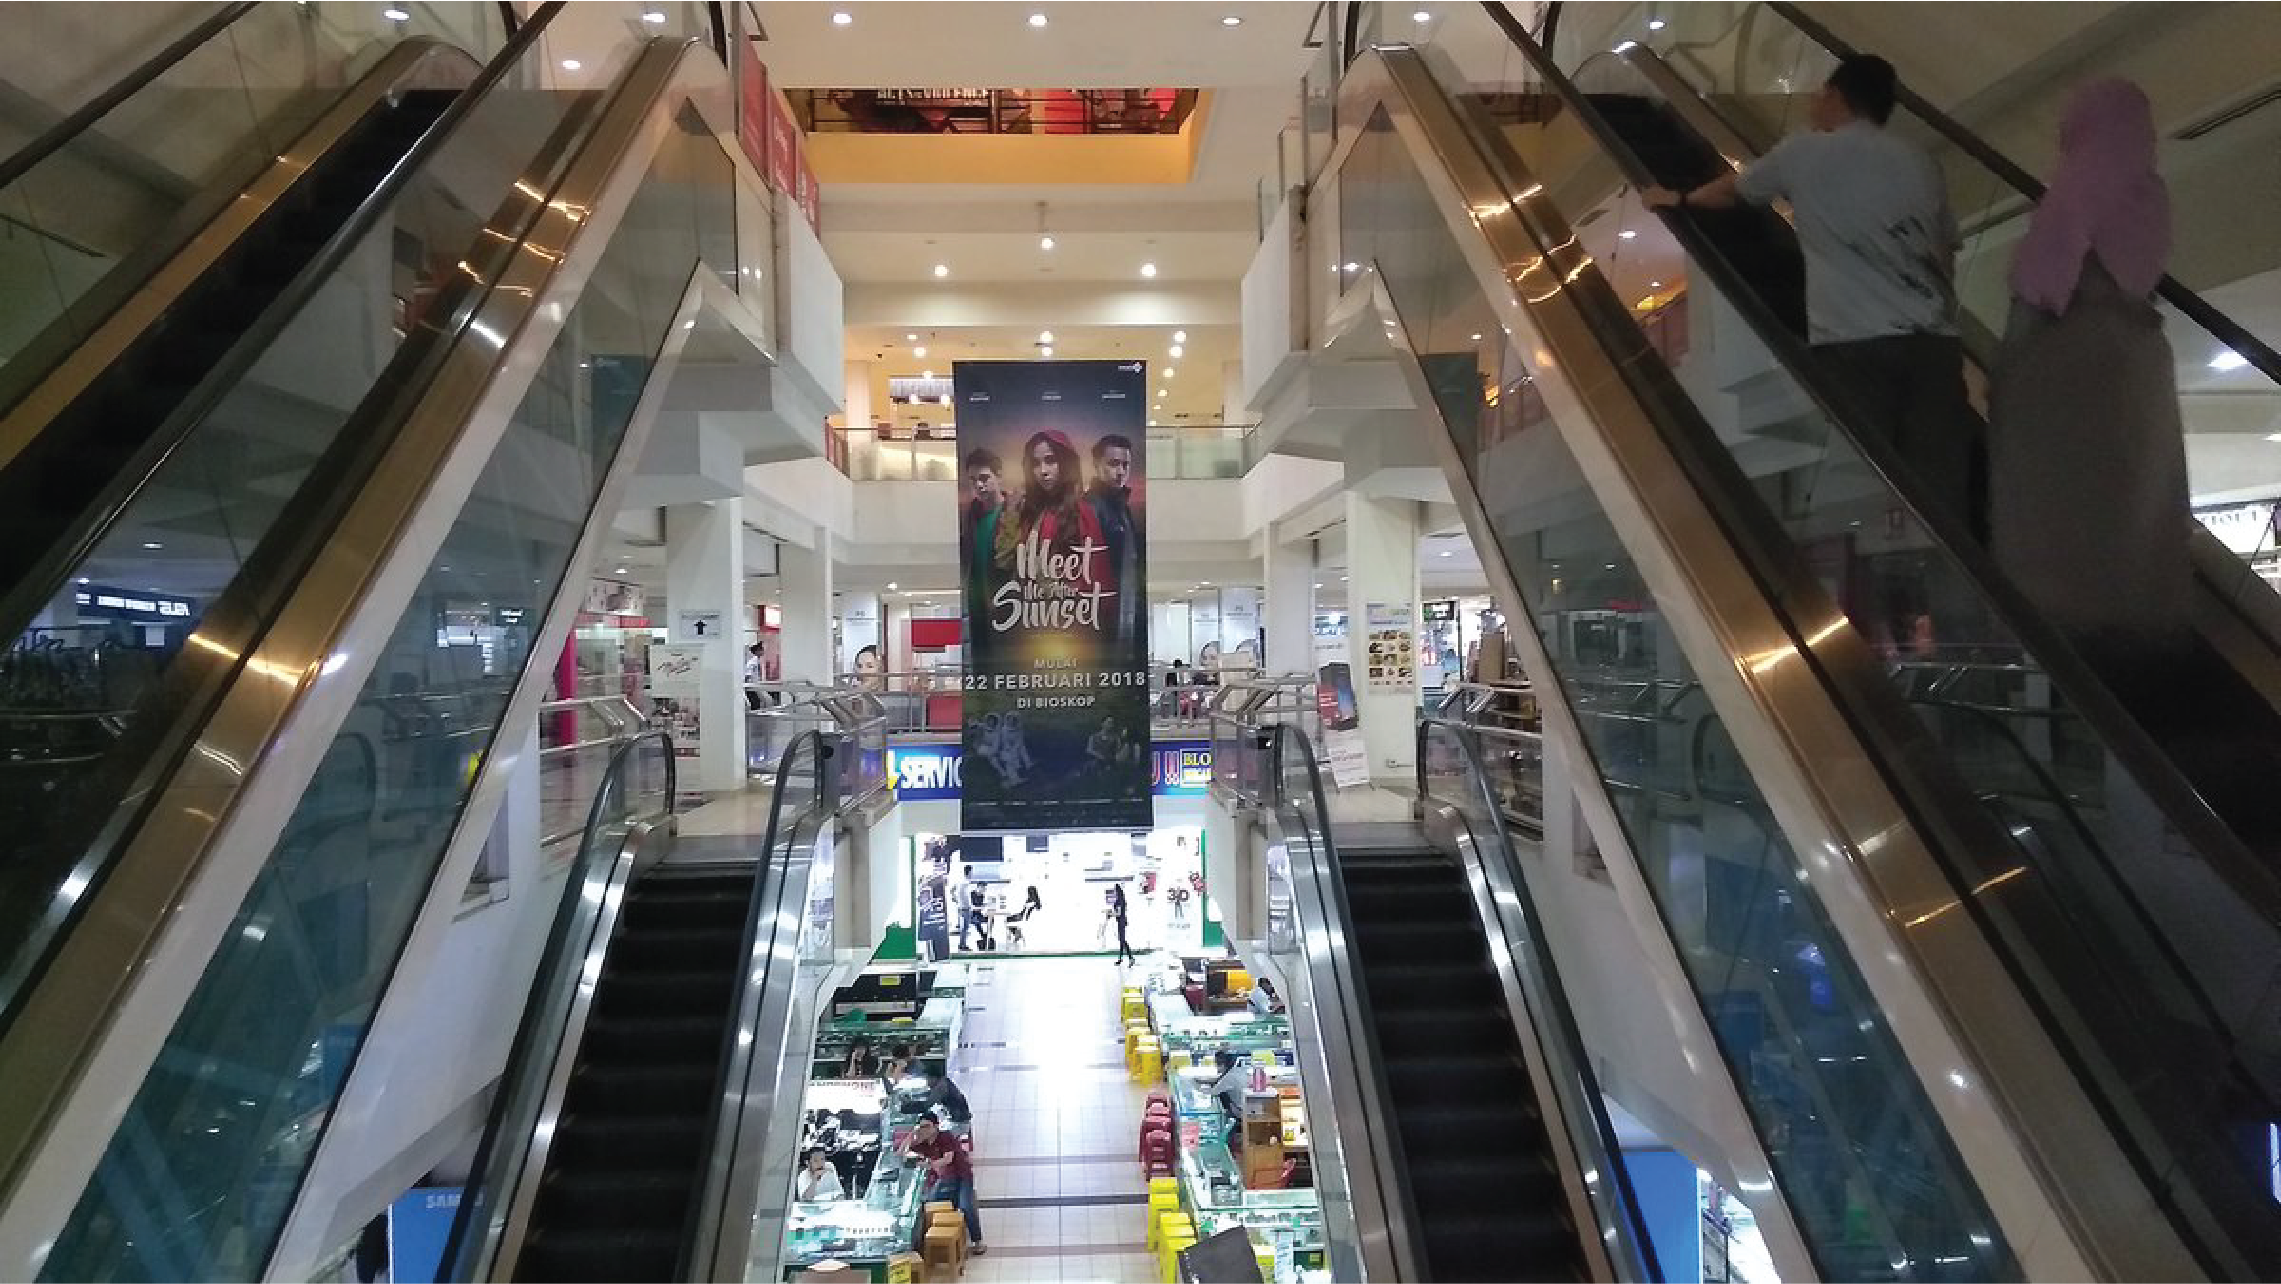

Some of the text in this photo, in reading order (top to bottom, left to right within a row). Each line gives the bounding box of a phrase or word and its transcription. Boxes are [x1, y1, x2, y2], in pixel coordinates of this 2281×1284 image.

[1017, 530, 1110, 584] Meet
[992, 580, 1118, 631] Sunset
[1033, 657, 1078, 669] MULAI
[965, 671, 1146, 690] 22 FEBRUARI 2018
[1017, 695, 1096, 709] DI BIOSKOP
